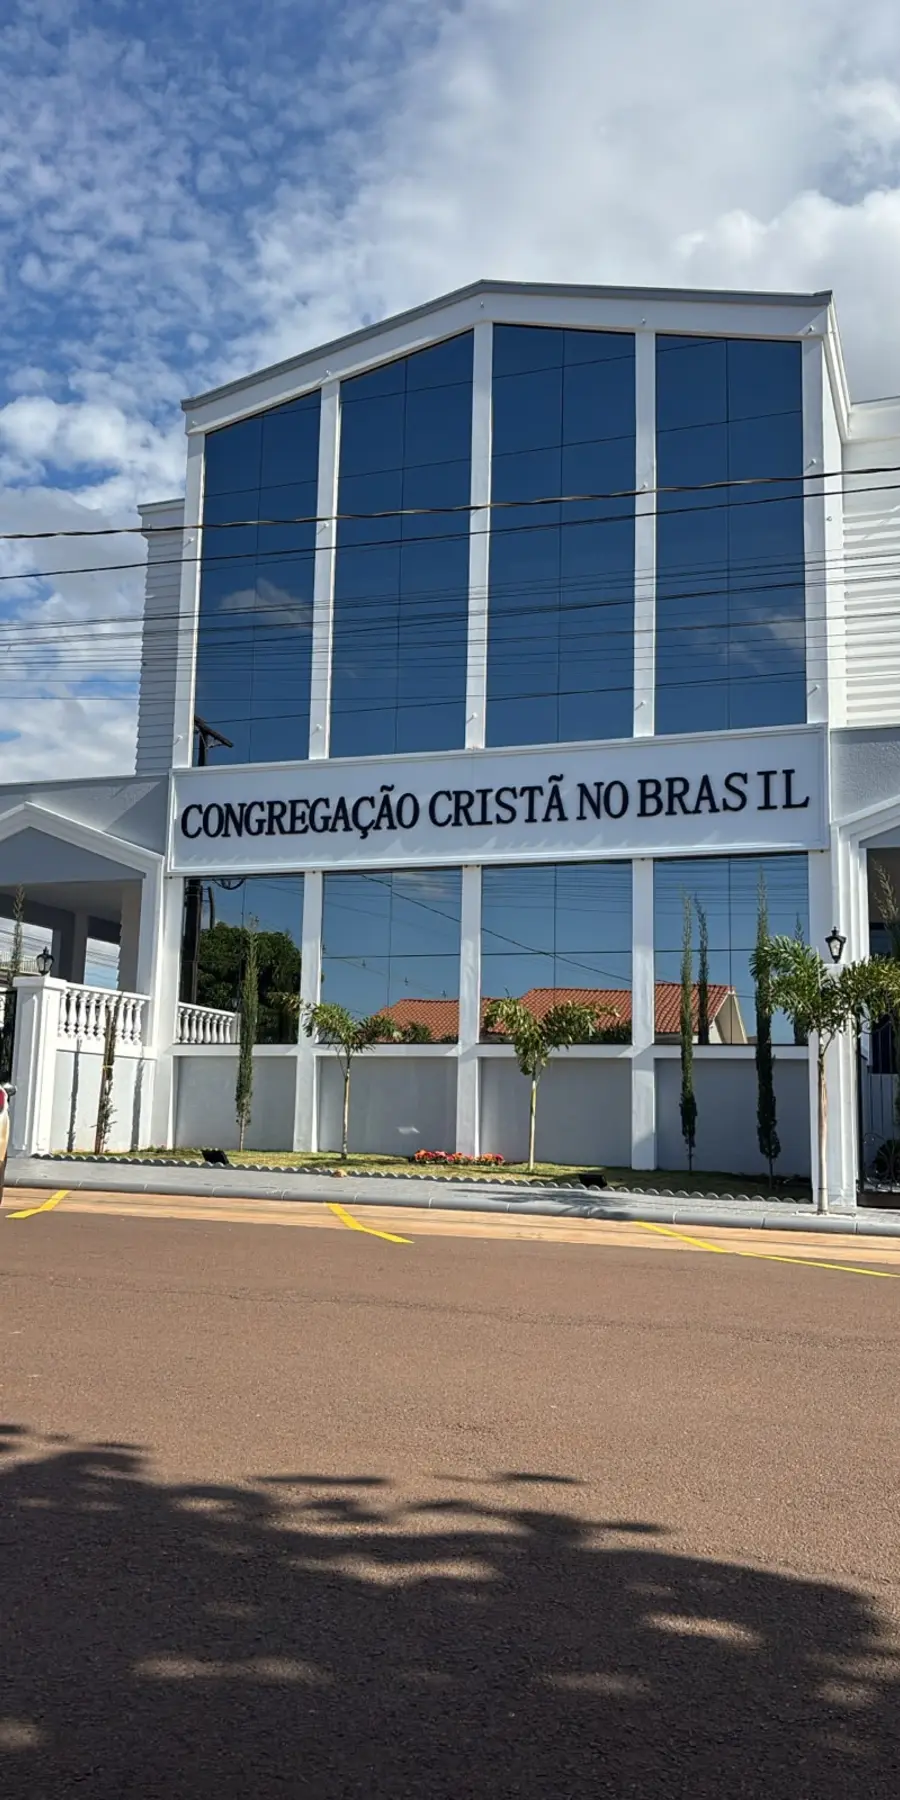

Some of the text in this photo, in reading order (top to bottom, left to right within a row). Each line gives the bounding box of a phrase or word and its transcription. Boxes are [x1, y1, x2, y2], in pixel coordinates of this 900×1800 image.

[181, 768, 810, 840] CONGREGAÇÃO CRISTÃ NO BRASIL
